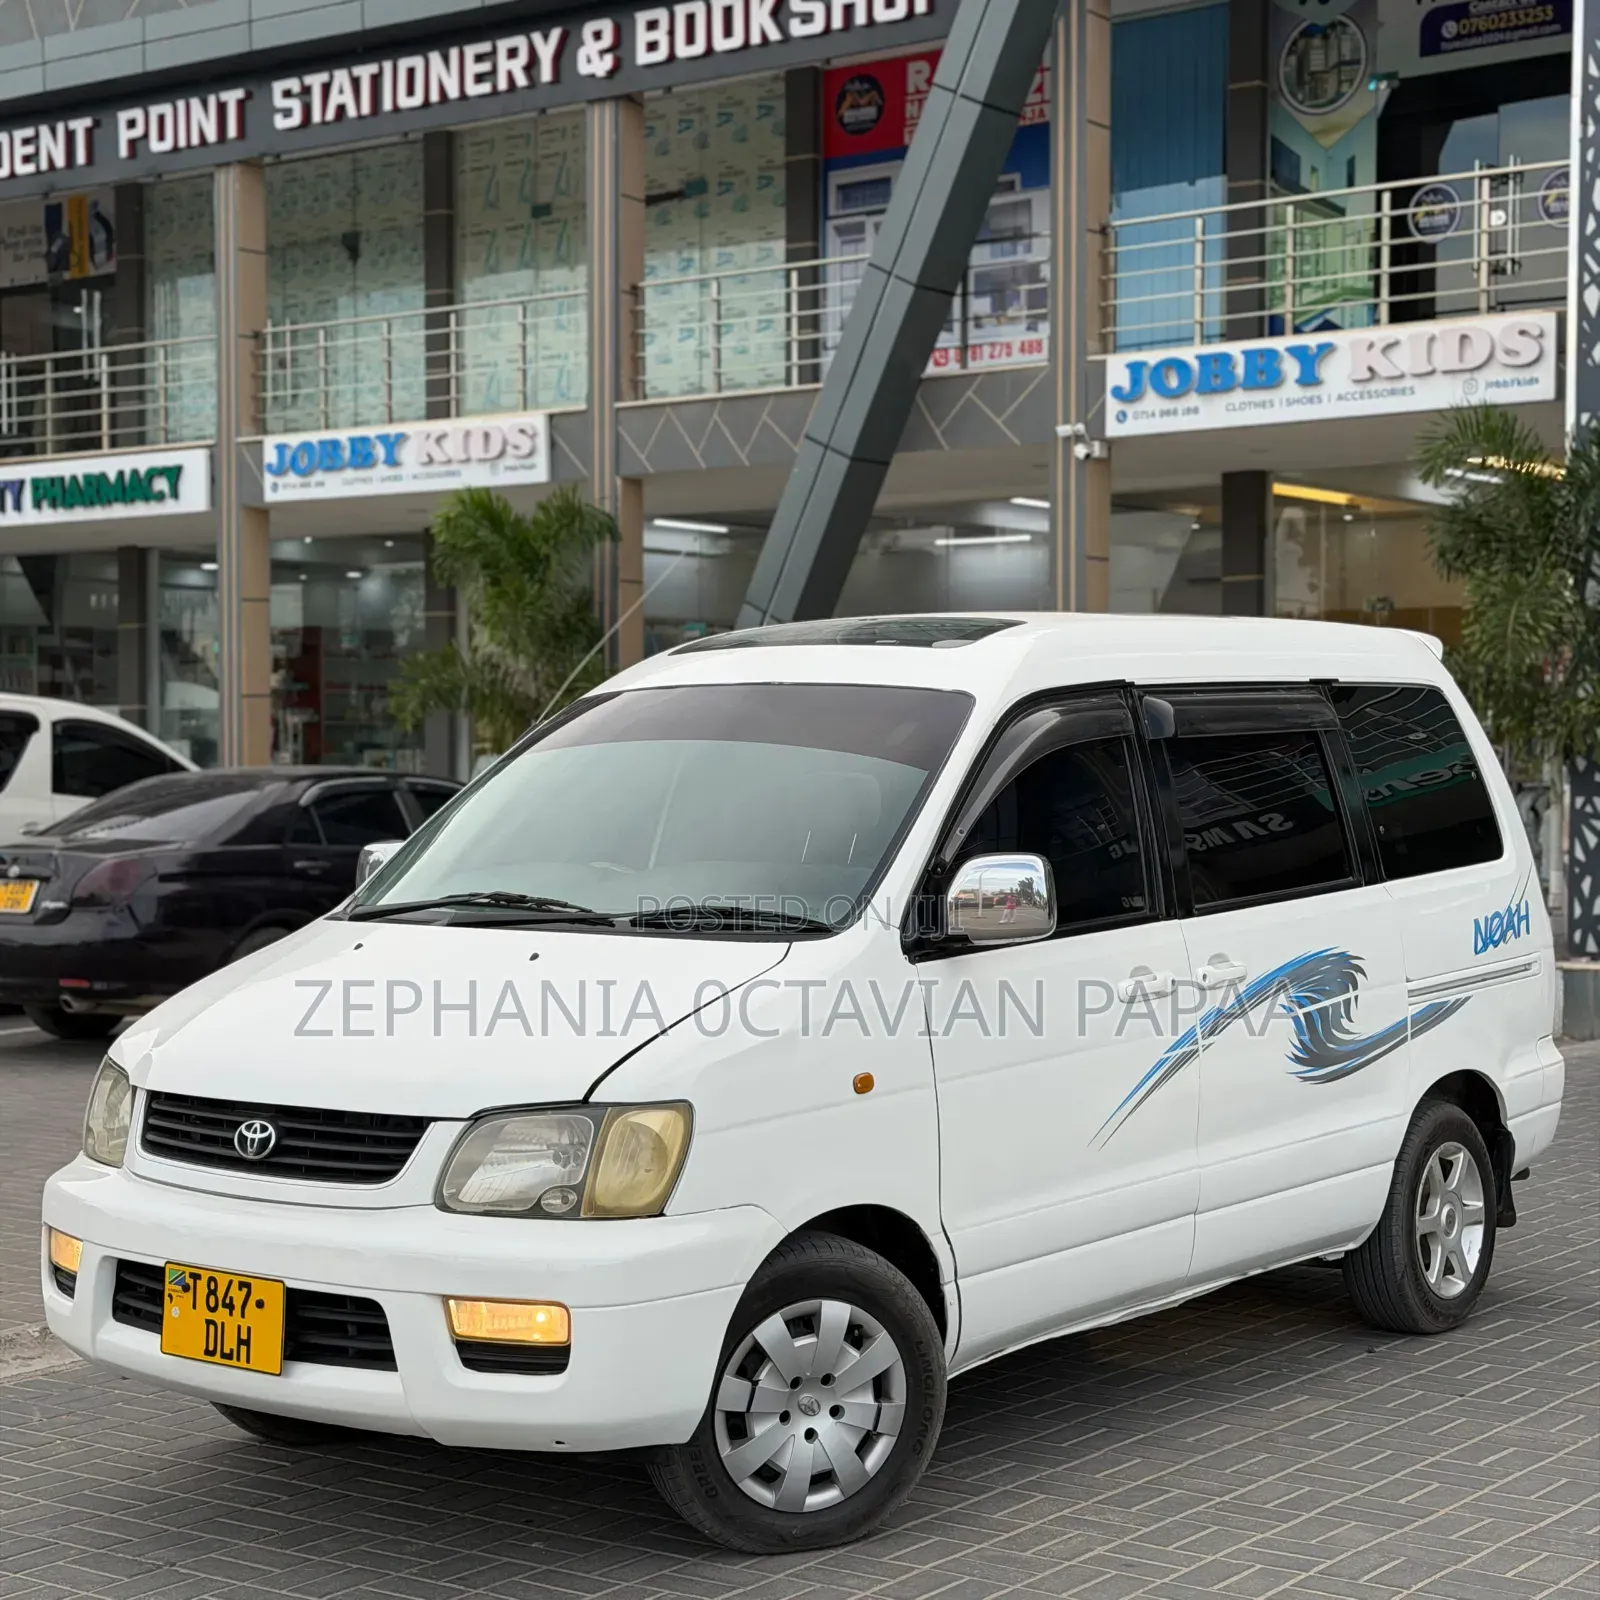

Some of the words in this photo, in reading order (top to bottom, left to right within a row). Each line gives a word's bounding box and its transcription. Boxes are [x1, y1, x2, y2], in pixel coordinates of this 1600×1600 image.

[1458, 4, 1554, 36] 0760233253
[116, 87, 248, 159] POINT
[272, 26, 566, 131] STATIONERY
[576, 17, 618, 78] &
[1111, 341, 1336, 402] JOBBY
[1350, 321, 1544, 384] KIDS
[1225, 399, 1275, 412] CLOTHES
[1286, 394, 1322, 408] SHOES
[1336, 386, 1416, 402] ACCESSORIES
[265, 432, 408, 477] JOBBY
[414, 422, 537, 466] KIDS
[31, 464, 183, 511] PHARMACY
[1472, 899, 1531, 957] NOAH
[203, 1318, 252, 1365] DLH
